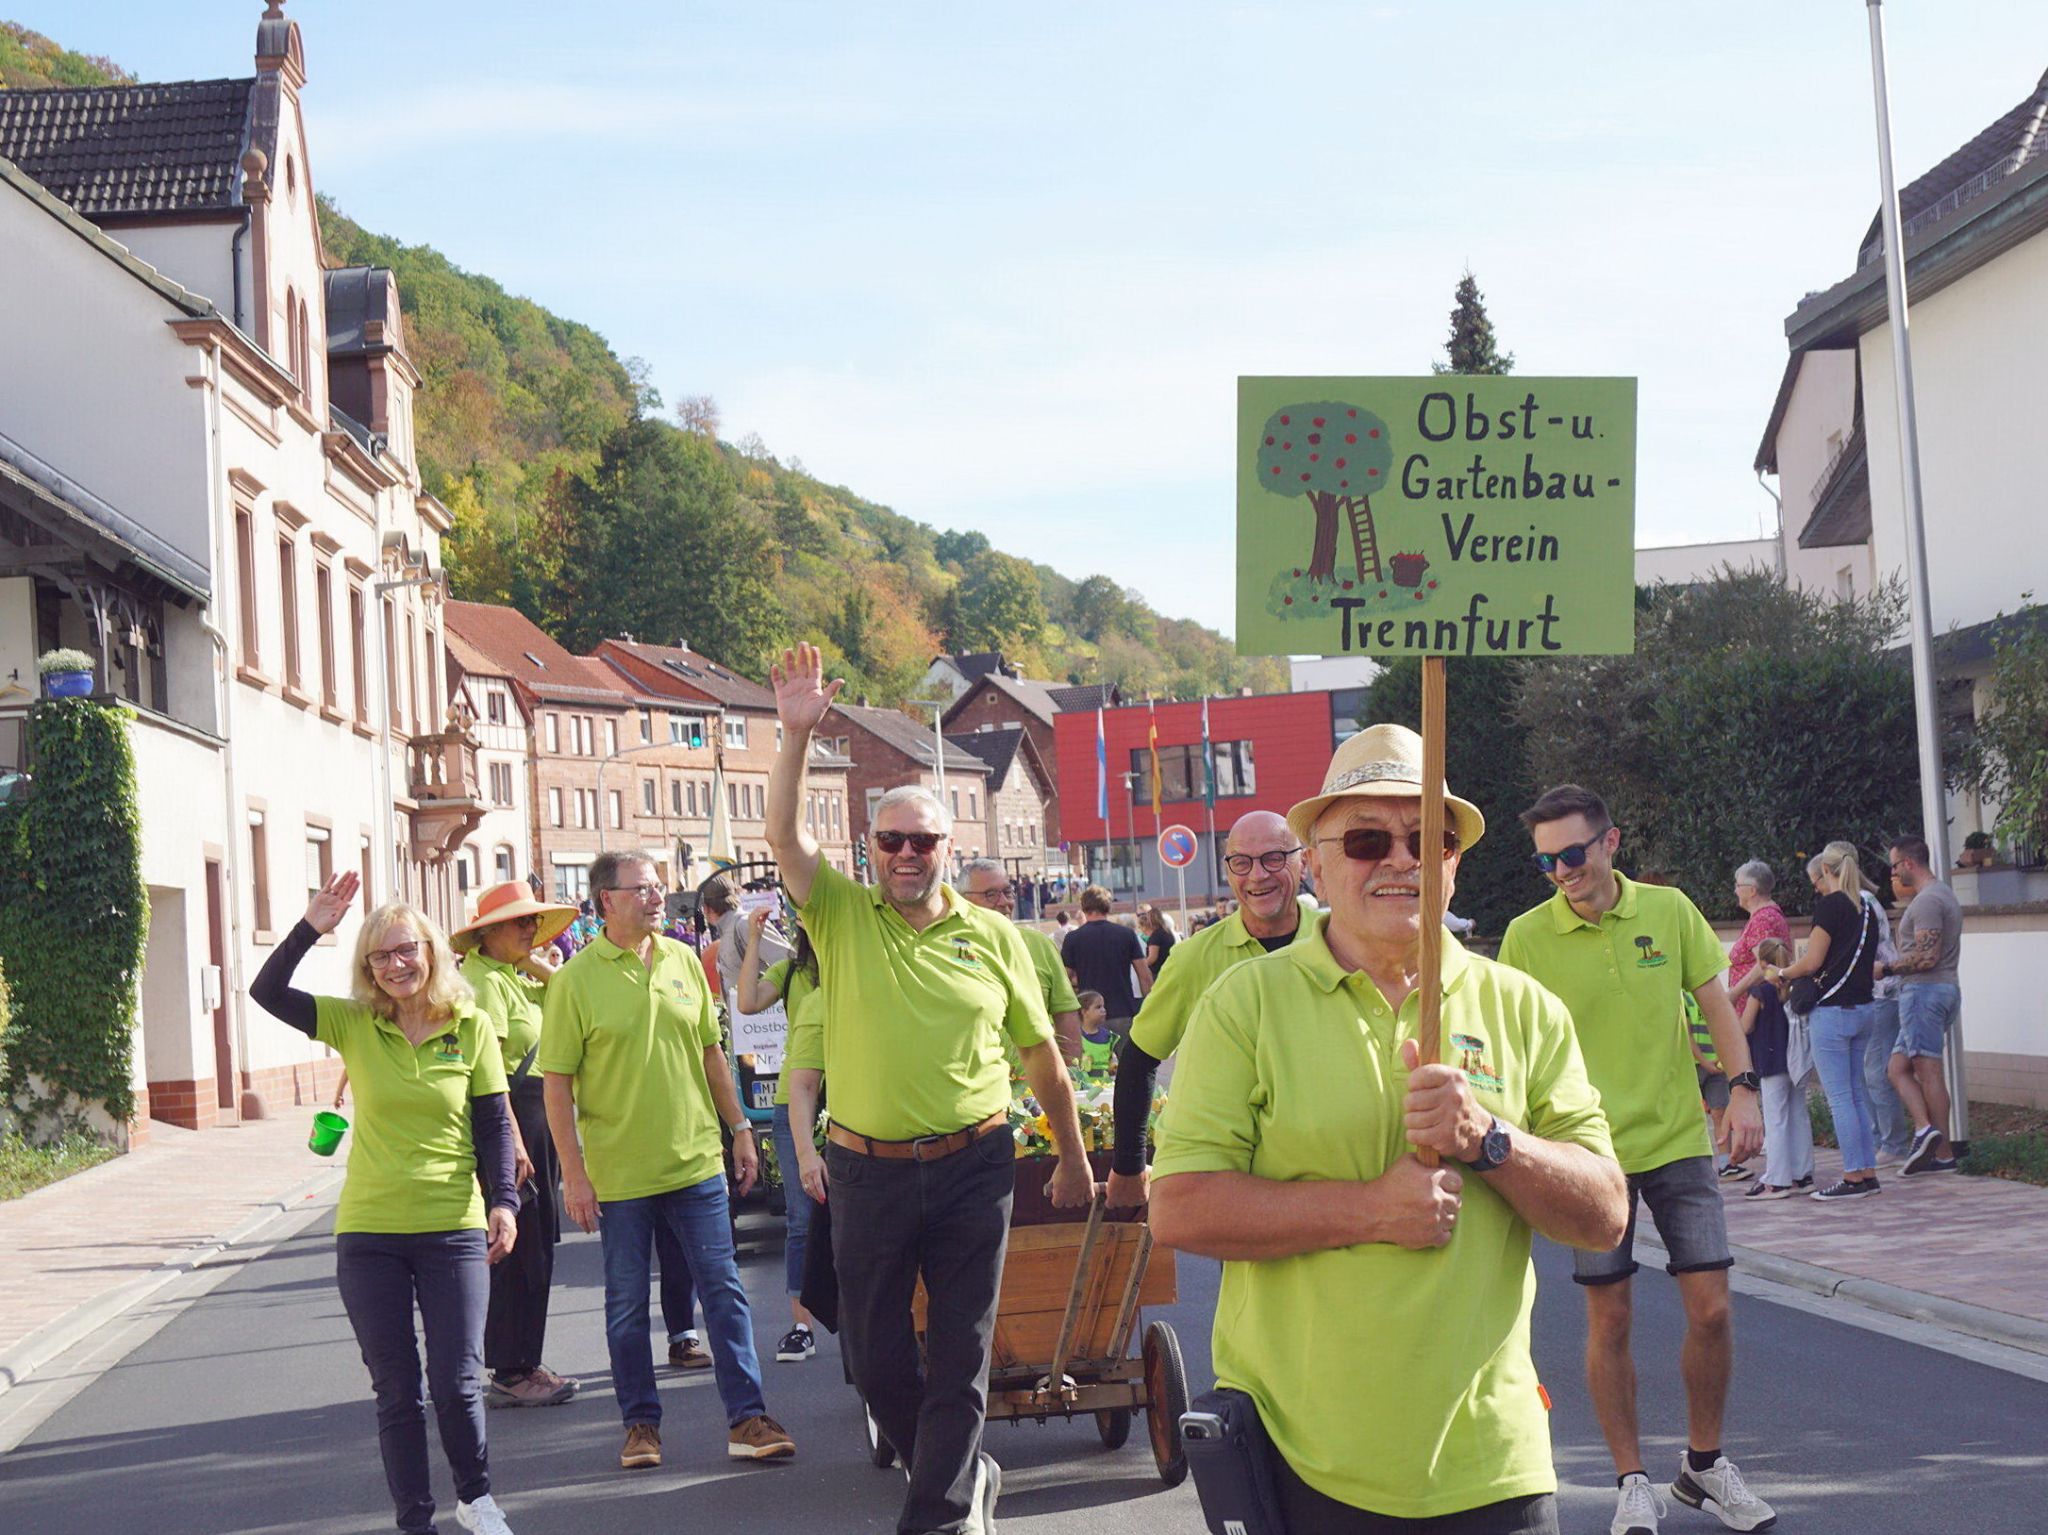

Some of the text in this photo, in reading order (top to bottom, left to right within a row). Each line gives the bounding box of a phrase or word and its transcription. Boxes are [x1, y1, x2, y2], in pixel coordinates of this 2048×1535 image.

[1401, 452, 1621, 500] Gartenbau-
[1441, 513, 1559, 562] Verein
[1330, 593, 1562, 656] Trennfurt
